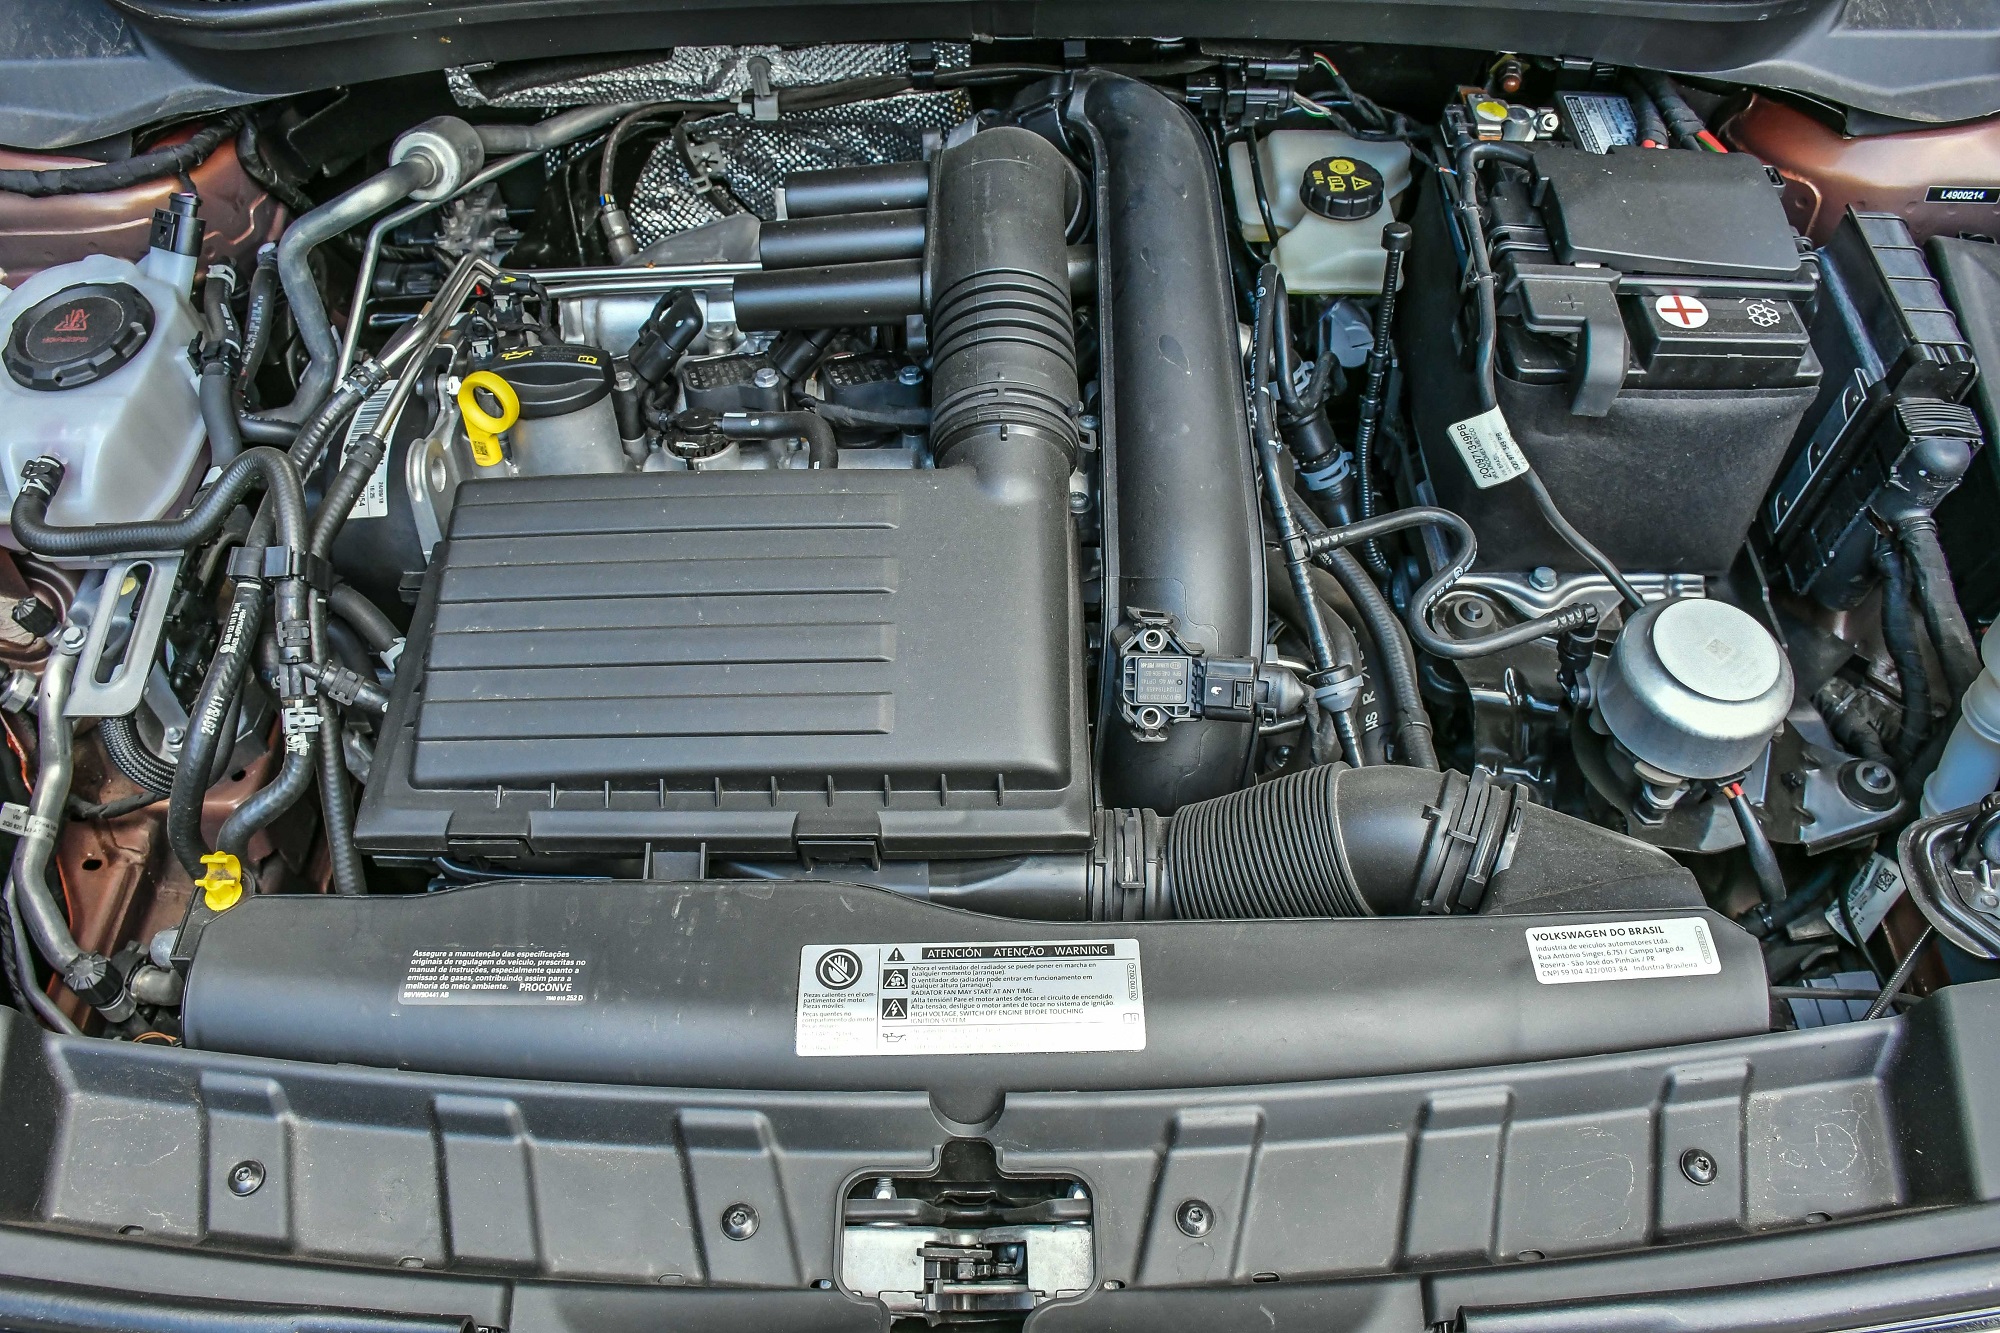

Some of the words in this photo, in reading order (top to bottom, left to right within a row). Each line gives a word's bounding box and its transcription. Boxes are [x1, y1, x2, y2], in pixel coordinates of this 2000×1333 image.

[1940, 190, 1985, 199] L4900214
[201, 695, 225, 736] 2018/11
[1533, 929, 1607, 941] VOLKSWAGEN
[1610, 928, 1625, 937] DO
[1629, 926, 1664, 935] BRASIL
[1608, 940, 1652, 948] automotores
[413, 950, 447, 958] Assegure
[455, 950, 500, 958] manutenção
[517, 951, 570, 959] especificações
[927, 947, 982, 958] ATENCIÓN
[994, 945, 1044, 958] ATENÇÃO
[1055, 946, 1108, 955] WARNING
[411, 958, 443, 966] originais
[455, 958, 494, 966] regulagem
[449, 966, 489, 974] instruções,
[471, 982, 509, 990] ambiente.
[519, 983, 572, 992] PROCONVE
